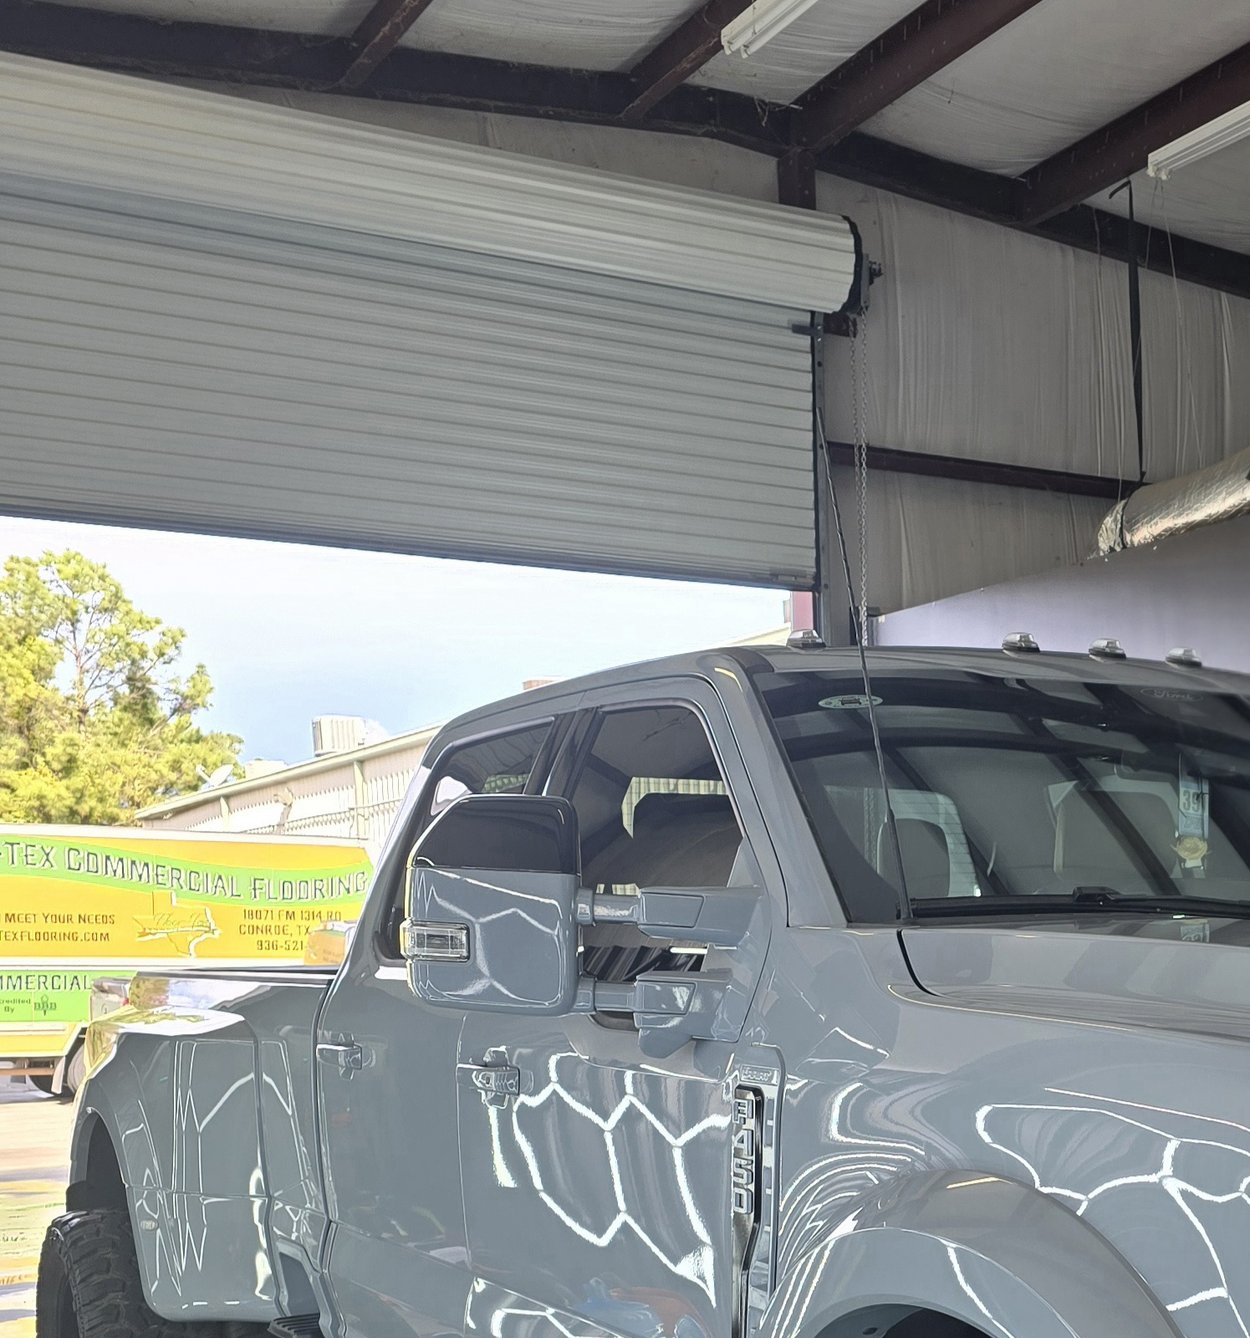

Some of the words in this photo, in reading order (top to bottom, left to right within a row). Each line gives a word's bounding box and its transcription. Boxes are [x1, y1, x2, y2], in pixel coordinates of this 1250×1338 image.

[66, 847, 242, 899] COMMERCIAL
[251, 871, 368, 901] FLOORING
[4, 912, 38, 925] MEET
[42, 912, 74, 925] YOUR
[78, 913, 116, 925] NEEDS
[297, 925, 311, 936] TX
[0, 974, 92, 991] MERCIAL
